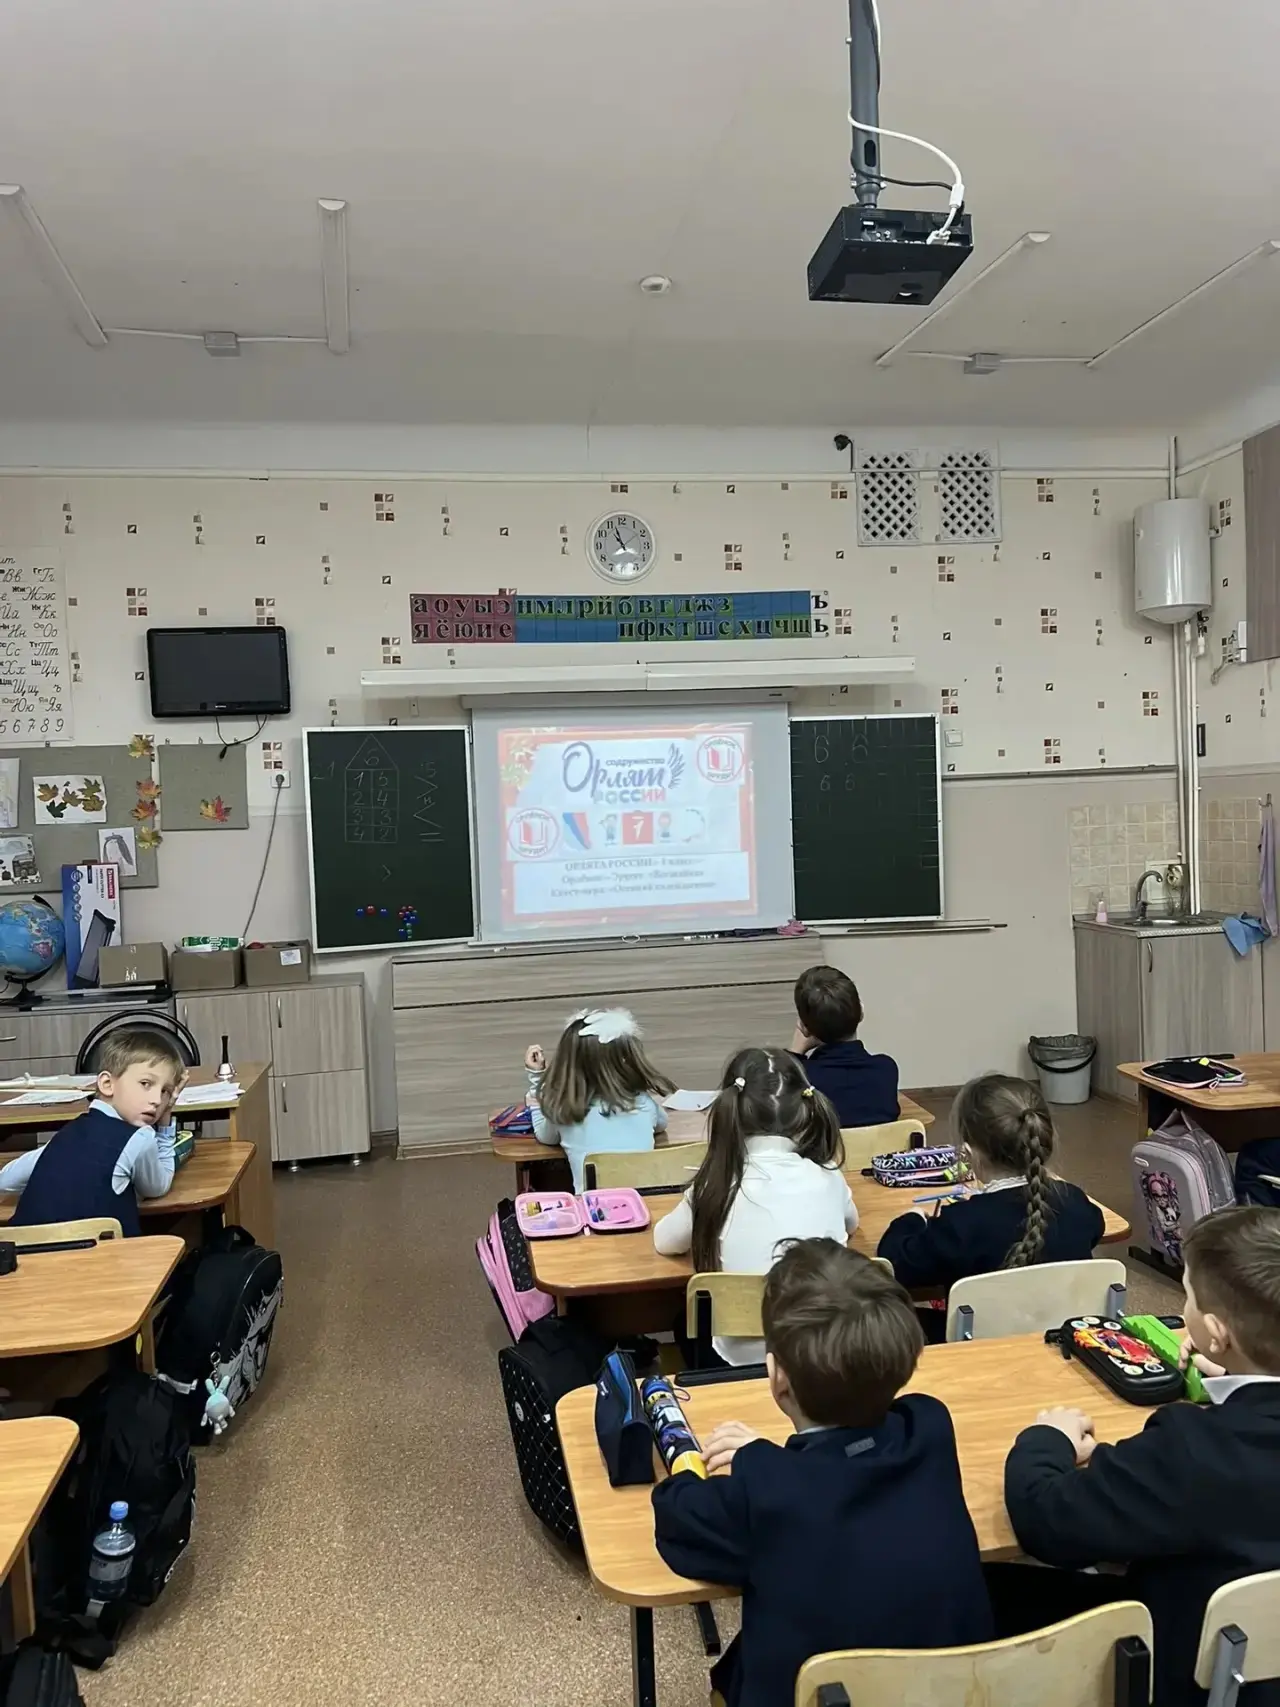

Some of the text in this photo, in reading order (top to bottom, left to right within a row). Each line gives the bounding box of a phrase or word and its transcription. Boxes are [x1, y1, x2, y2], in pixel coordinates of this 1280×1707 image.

[607, 521, 613, 529] 11
[618, 517, 626, 525] 12
[597, 529, 607, 538] 10
[640, 529, 646, 538] 2
[13, 719, 21, 733] 6
[28, 718, 36, 733] 7
[40, 718, 50, 733] 8
[55, 718, 64, 732] 9
[815, 735, 829, 764] 6
[562, 741, 666, 798] Орлят
[354, 771, 364, 788] 1
